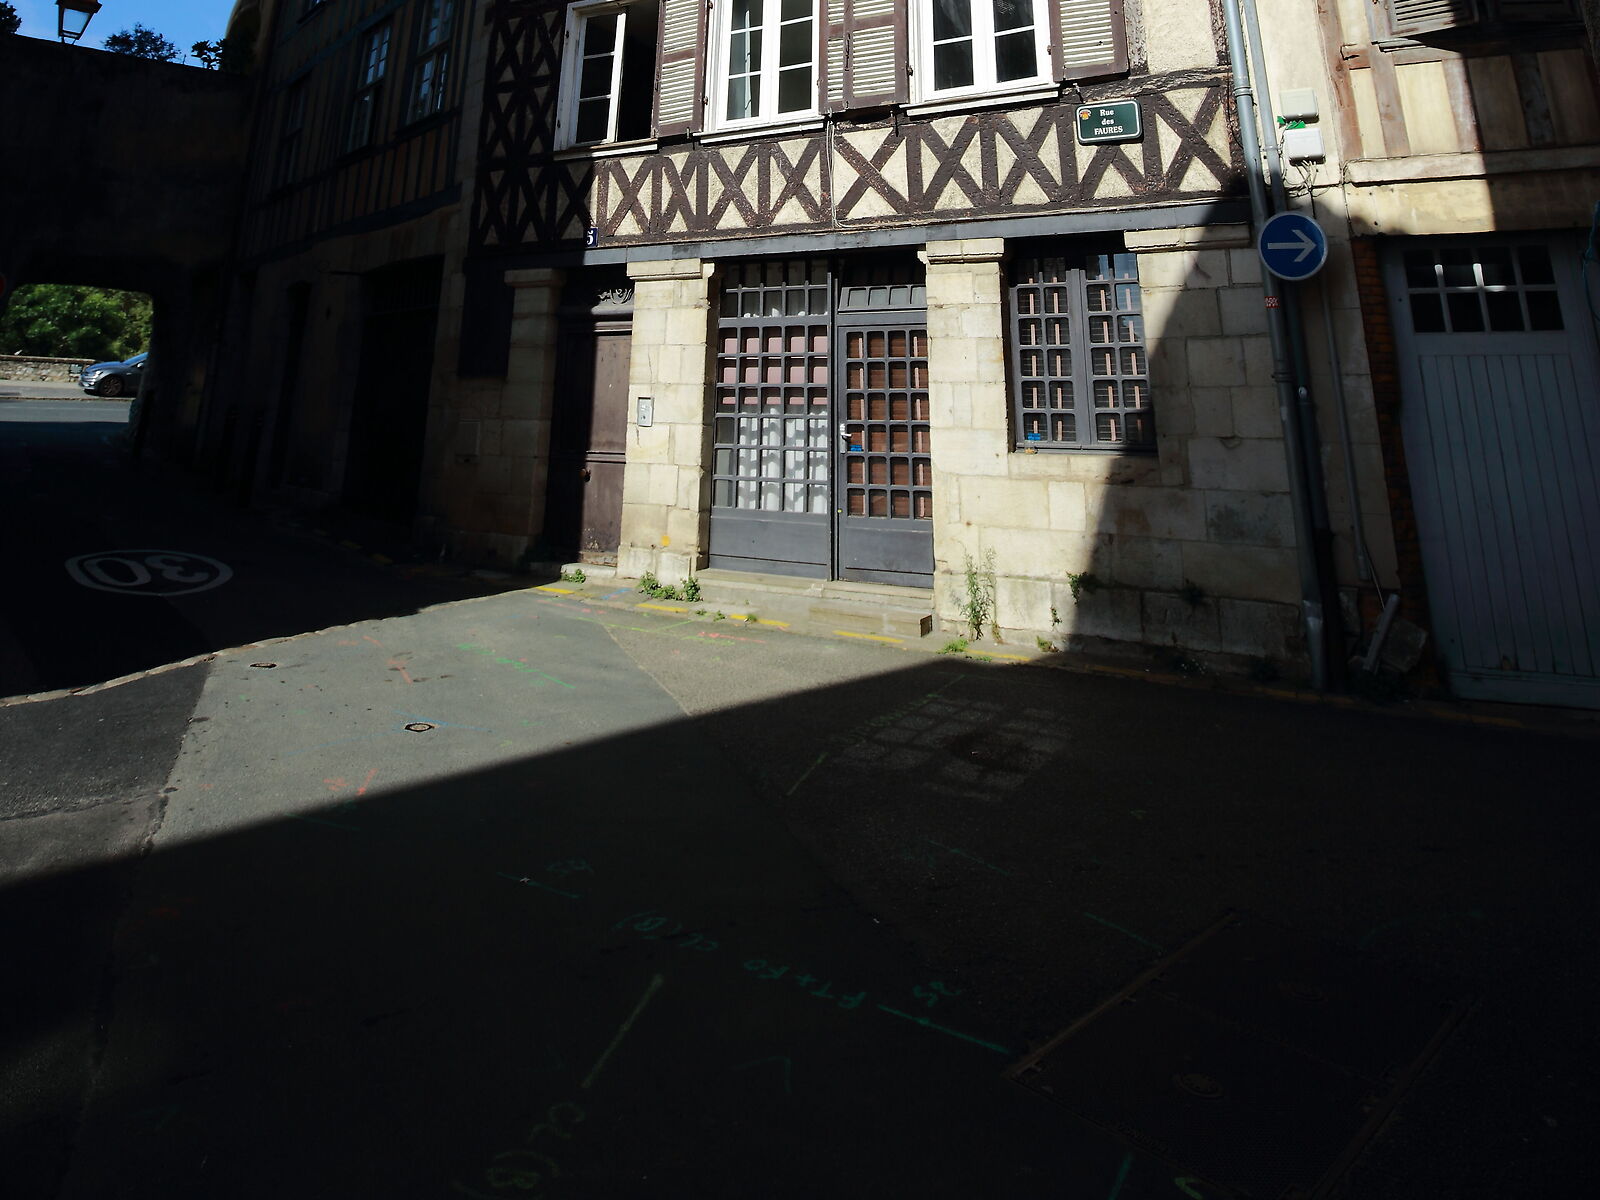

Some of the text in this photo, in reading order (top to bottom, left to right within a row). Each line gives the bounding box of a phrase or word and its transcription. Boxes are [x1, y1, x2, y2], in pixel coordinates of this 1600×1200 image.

[1094, 126, 1123, 135] FAURES
[586, 229, 594, 245] 5
[82, 554, 210, 587] 30
